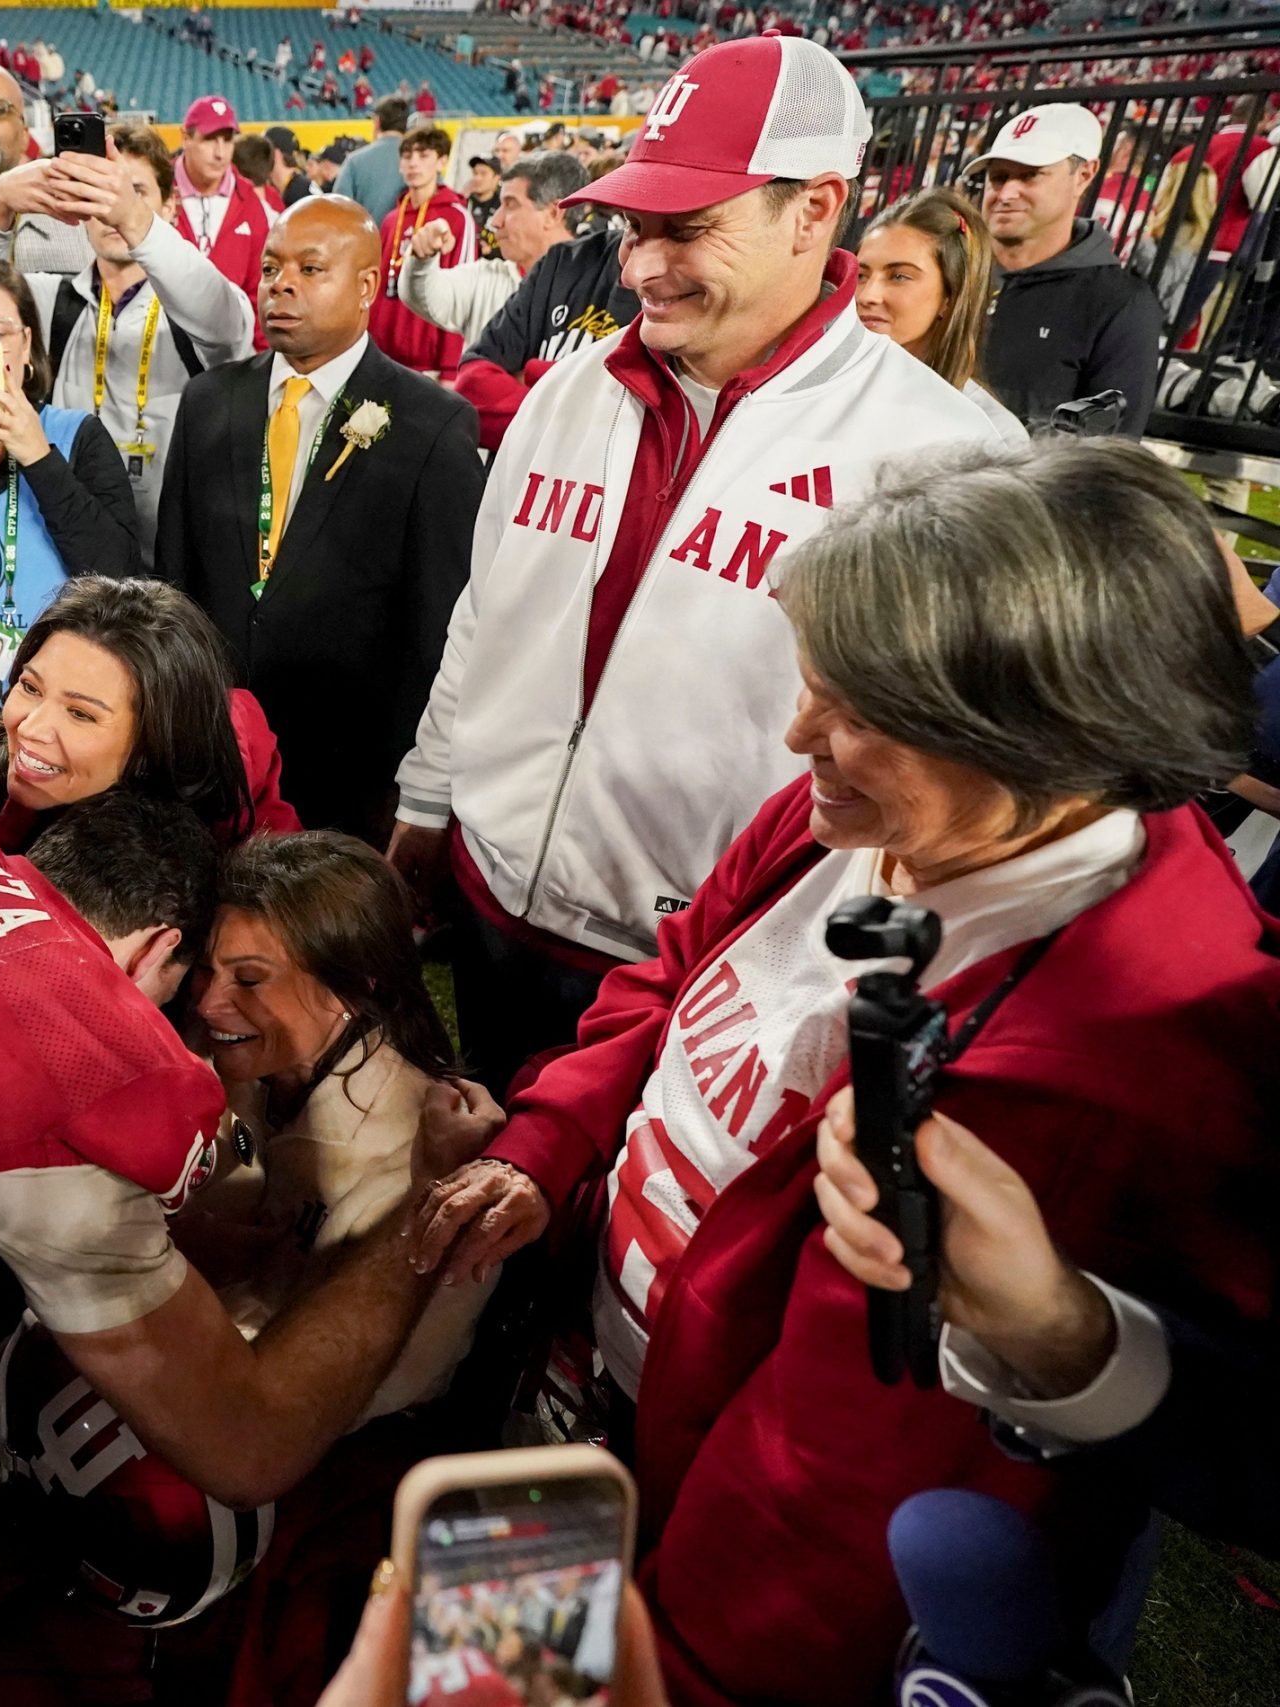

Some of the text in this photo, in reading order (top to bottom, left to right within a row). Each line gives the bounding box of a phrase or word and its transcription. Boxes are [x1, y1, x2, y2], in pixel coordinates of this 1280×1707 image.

[261, 465, 270, 485] CFP
[8, 475, 18, 517] NATIONAL
[7, 518, 17, 537] CFP
[669, 506, 789, 600] AN
